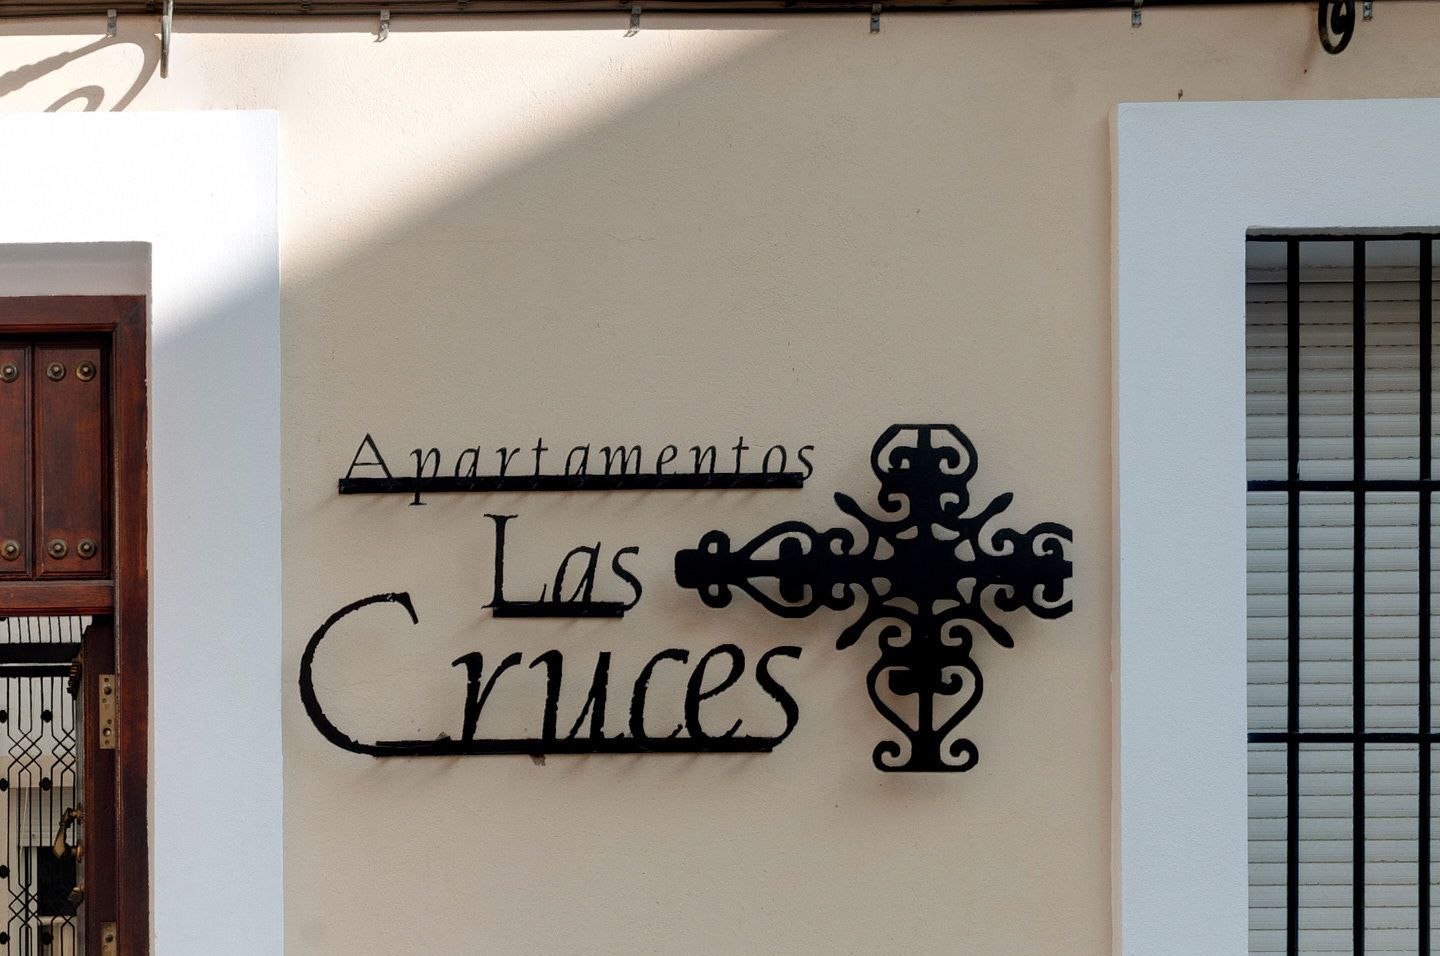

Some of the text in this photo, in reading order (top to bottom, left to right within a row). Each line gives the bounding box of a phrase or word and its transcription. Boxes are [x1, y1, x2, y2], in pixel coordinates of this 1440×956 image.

[344, 432, 816, 506] Apartamentos
[481, 513, 642, 610] Las
[298, 591, 802, 755] Cruces
